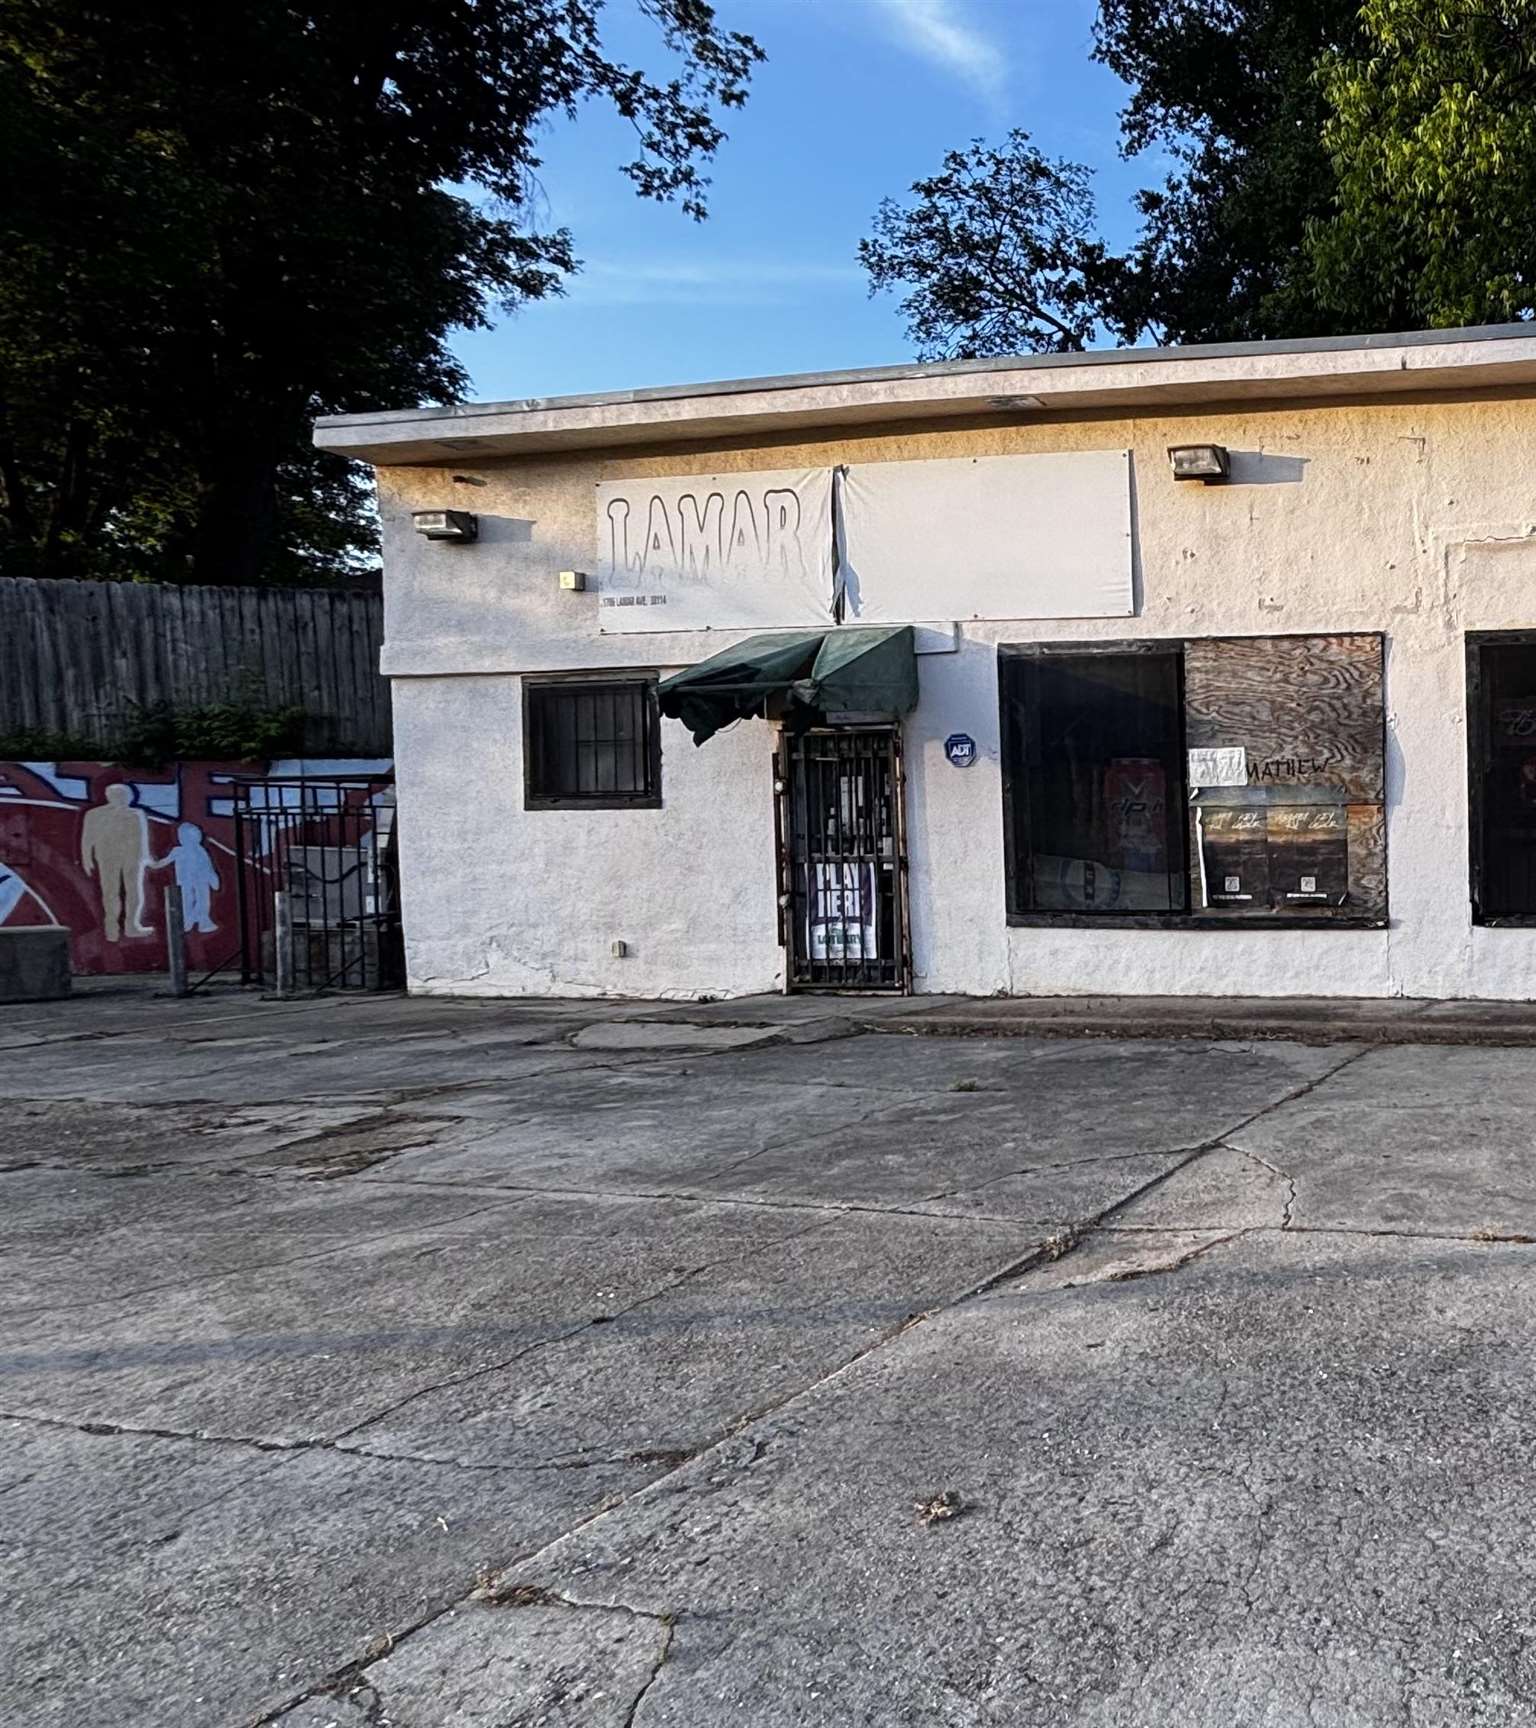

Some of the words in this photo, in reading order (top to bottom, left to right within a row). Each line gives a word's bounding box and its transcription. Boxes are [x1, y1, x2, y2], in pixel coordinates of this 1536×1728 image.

[607, 489, 807, 589] LAMAR
[951, 744, 972, 757] ADT
[816, 862, 860, 890] PLAY
